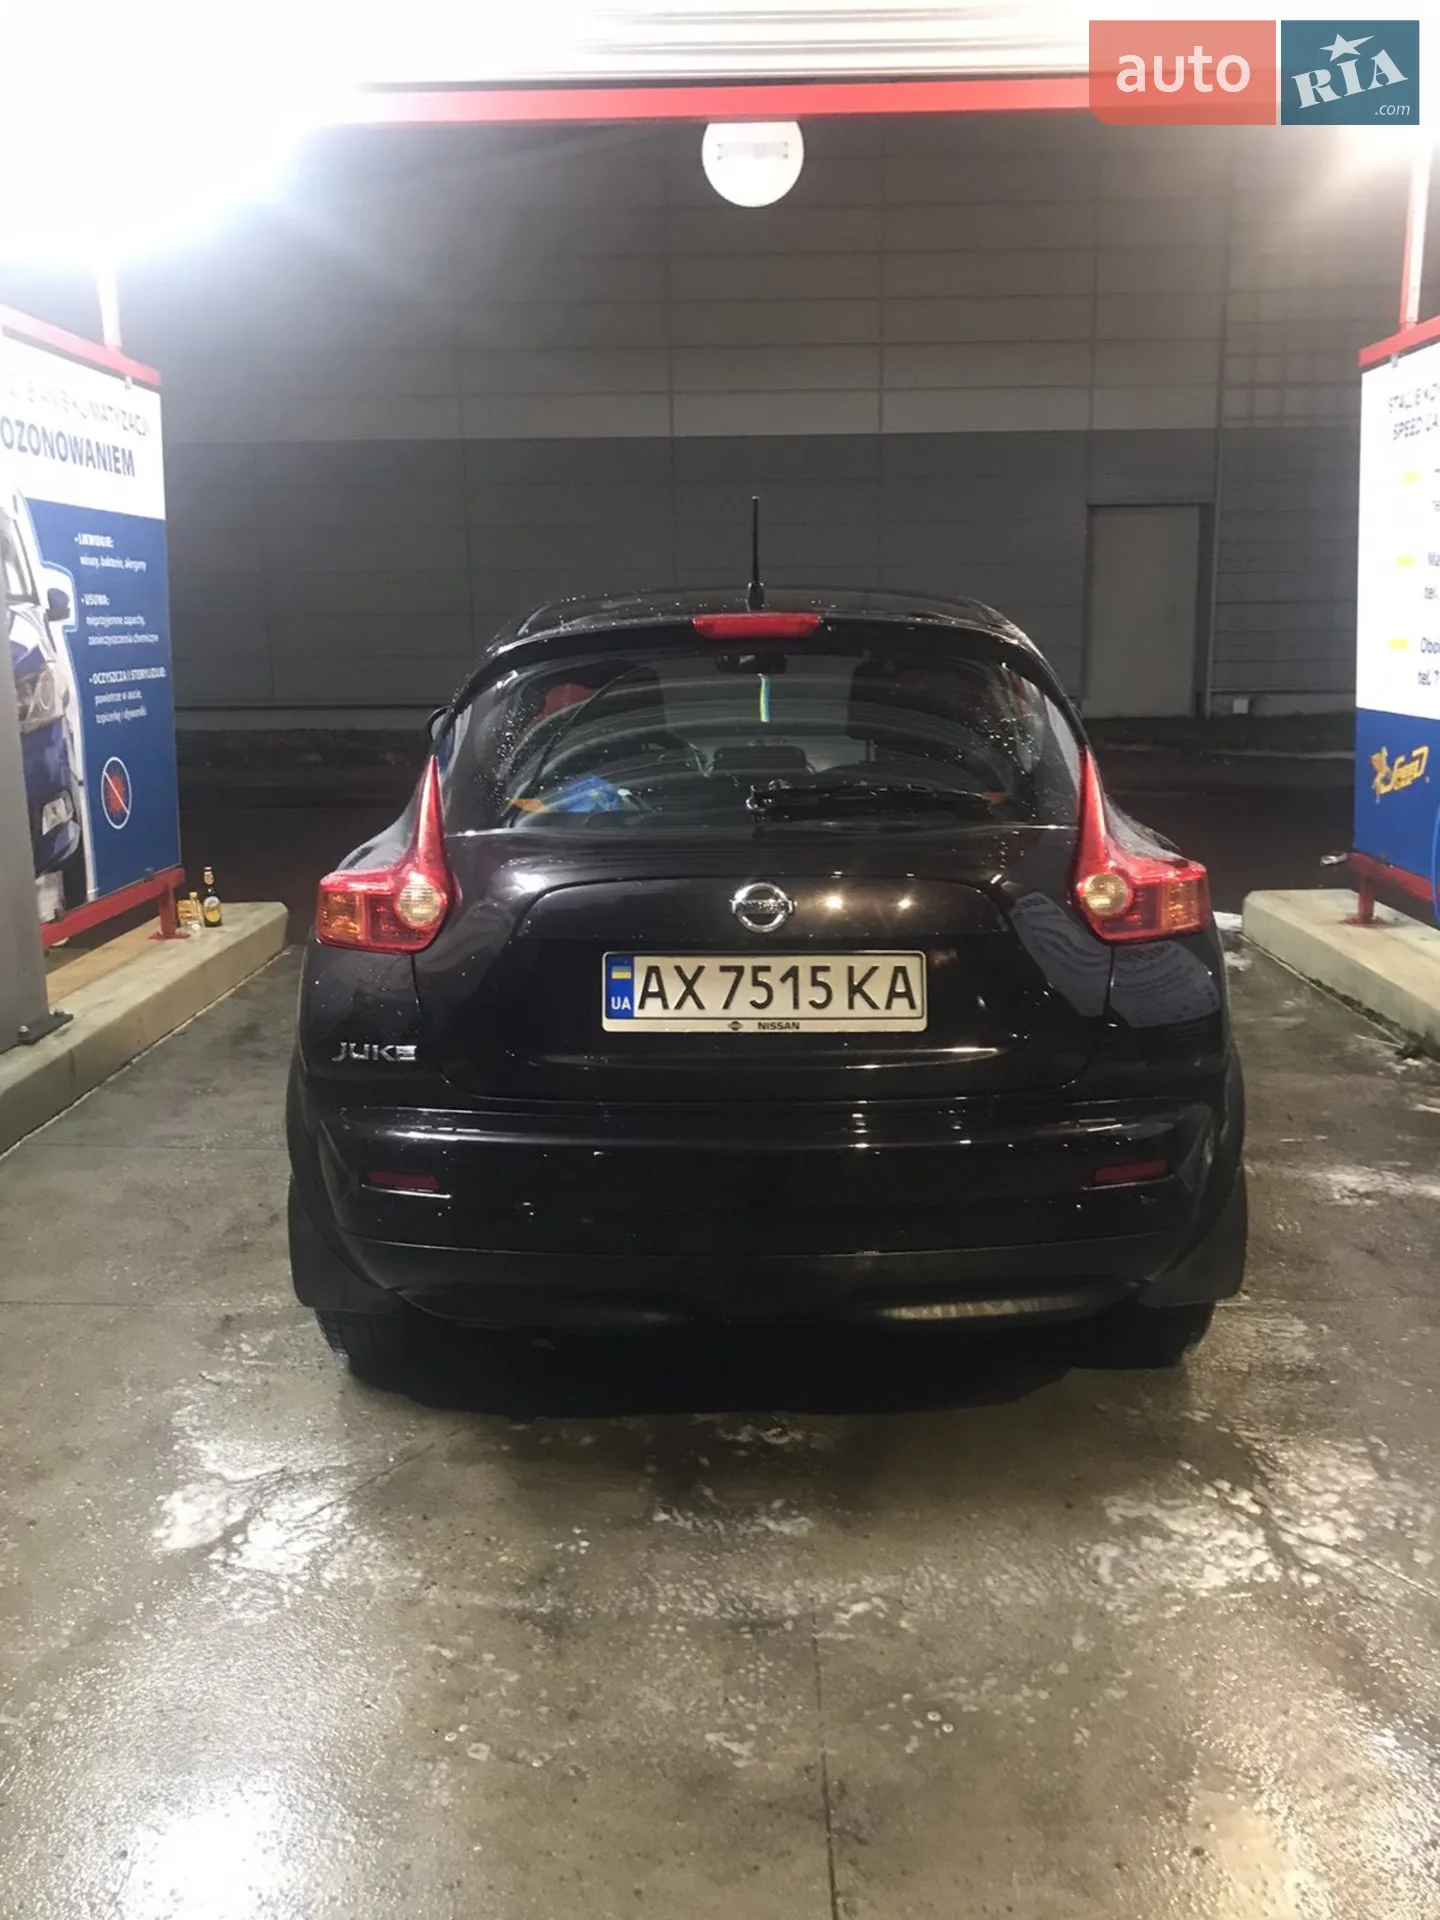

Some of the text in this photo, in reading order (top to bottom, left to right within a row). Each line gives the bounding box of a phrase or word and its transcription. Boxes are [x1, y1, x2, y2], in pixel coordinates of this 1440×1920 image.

[0, 415, 136, 478] OZONOWANIEM
[638, 964, 918, 1011] AX 7515 KA
[611, 996, 632, 1011] UA
[757, 1021, 801, 1032] NISSAN
[331, 1041, 418, 1062] JUKE
